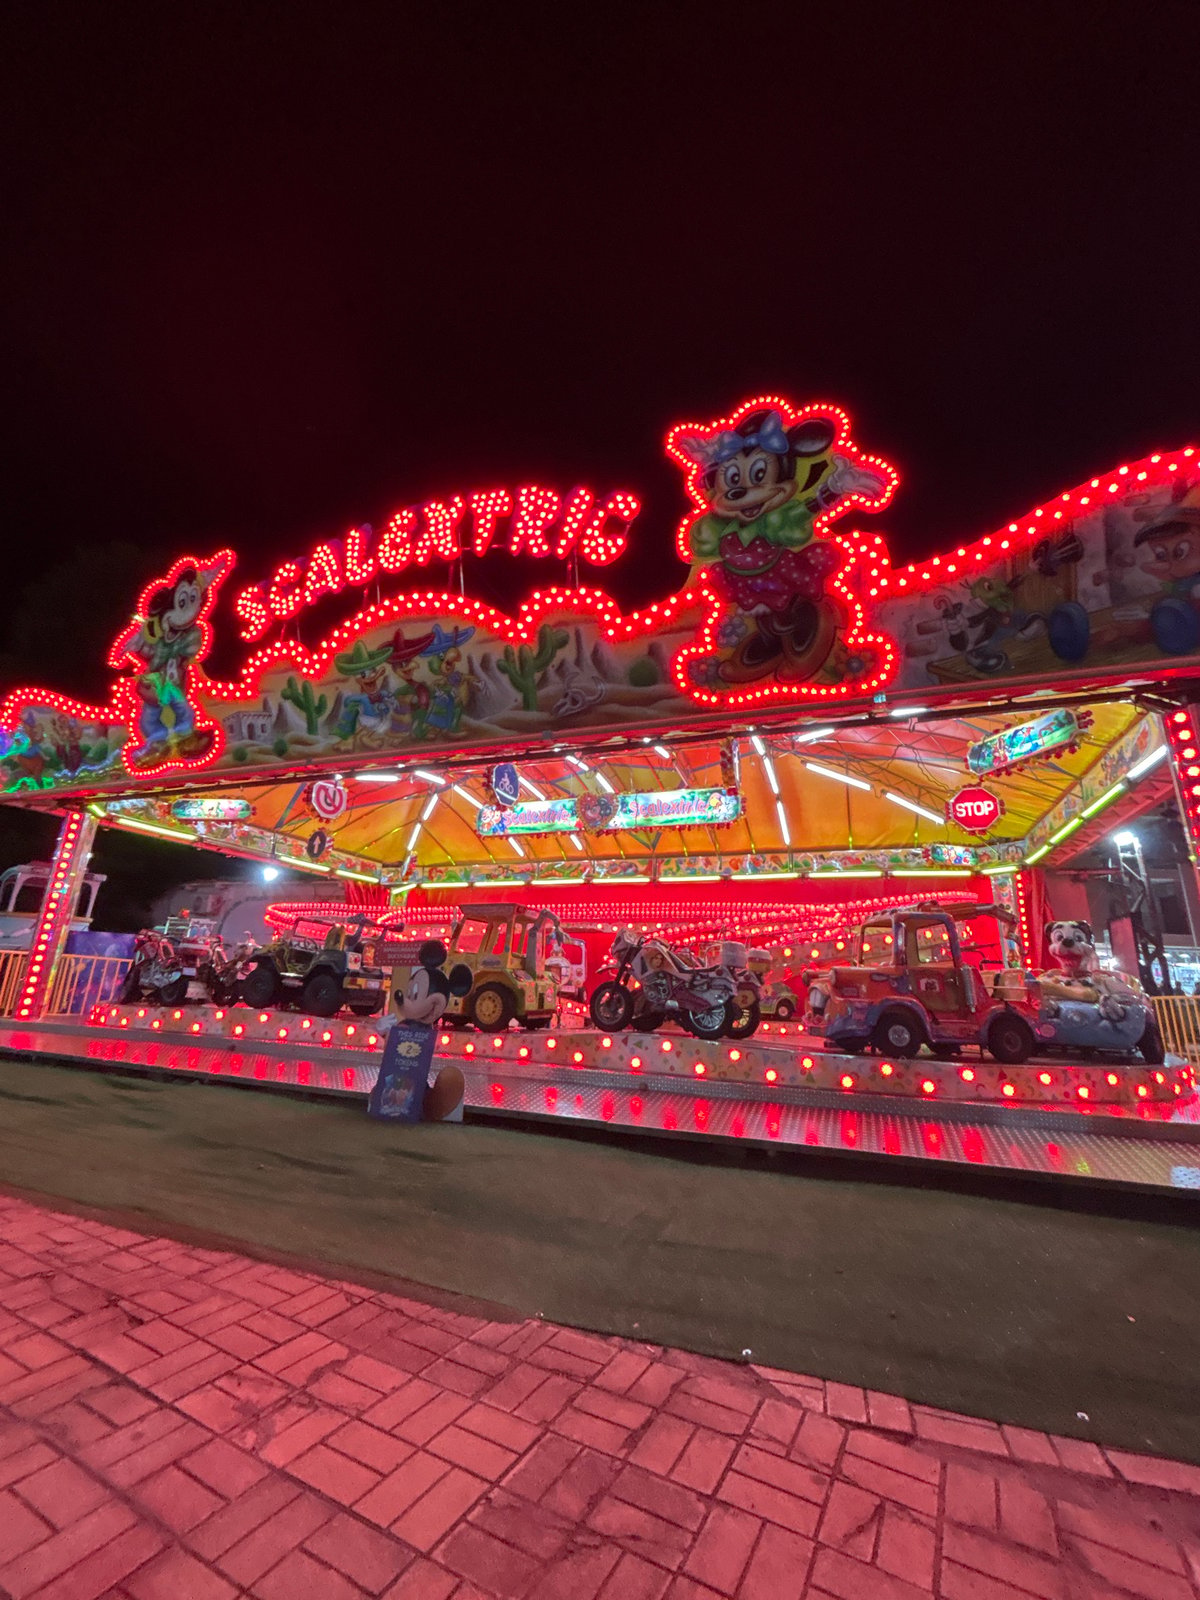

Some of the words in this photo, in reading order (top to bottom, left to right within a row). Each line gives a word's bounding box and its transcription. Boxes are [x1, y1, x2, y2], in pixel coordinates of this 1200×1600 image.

[236, 484, 641, 643] SCALEXTRIC
[503, 806, 570, 827] Scalextric
[629, 796, 707, 818] Scalextric
[955, 800, 994, 818] STOP
[405, 1044, 413, 1055] 2
